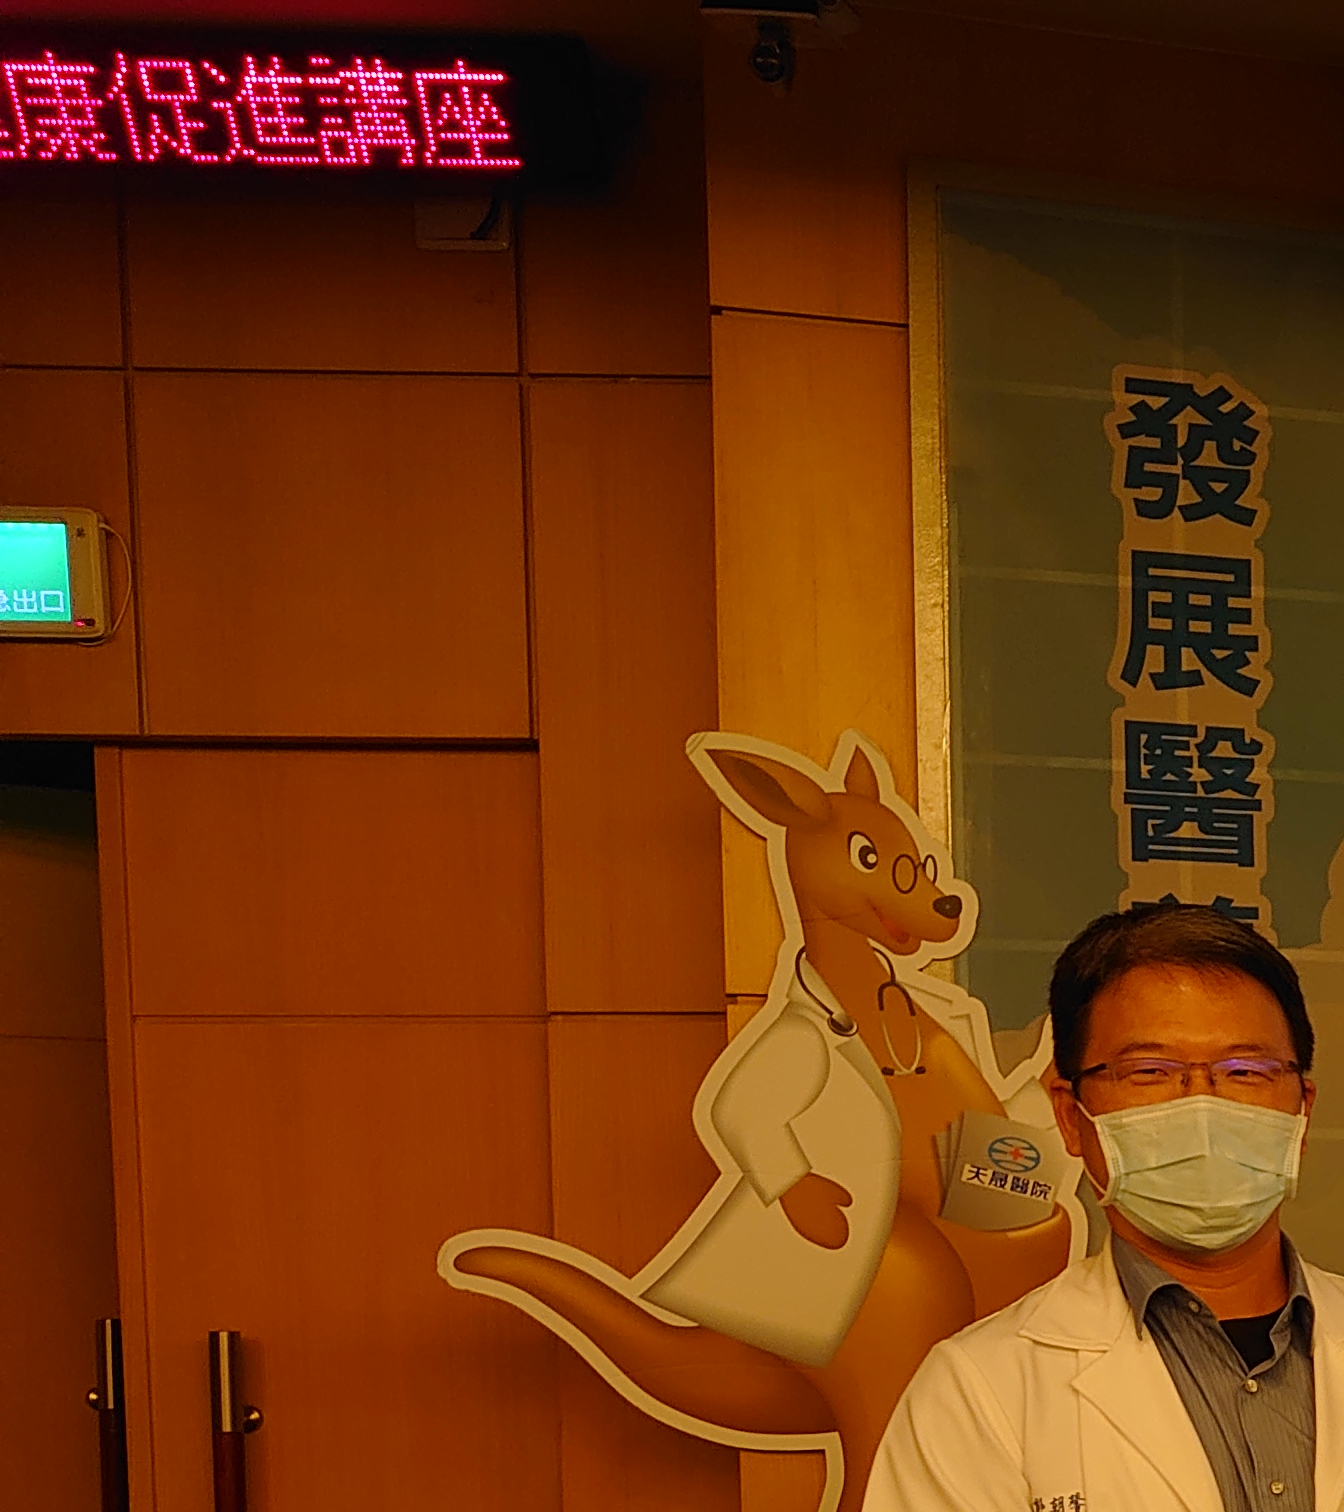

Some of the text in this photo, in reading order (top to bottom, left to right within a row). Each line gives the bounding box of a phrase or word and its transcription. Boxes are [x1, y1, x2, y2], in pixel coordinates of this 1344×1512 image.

[0, 50, 523, 167] 康促進講座
[1116, 376, 1263, 928] 發展醫
[966, 1165, 1052, 1200] 天晟醫院
